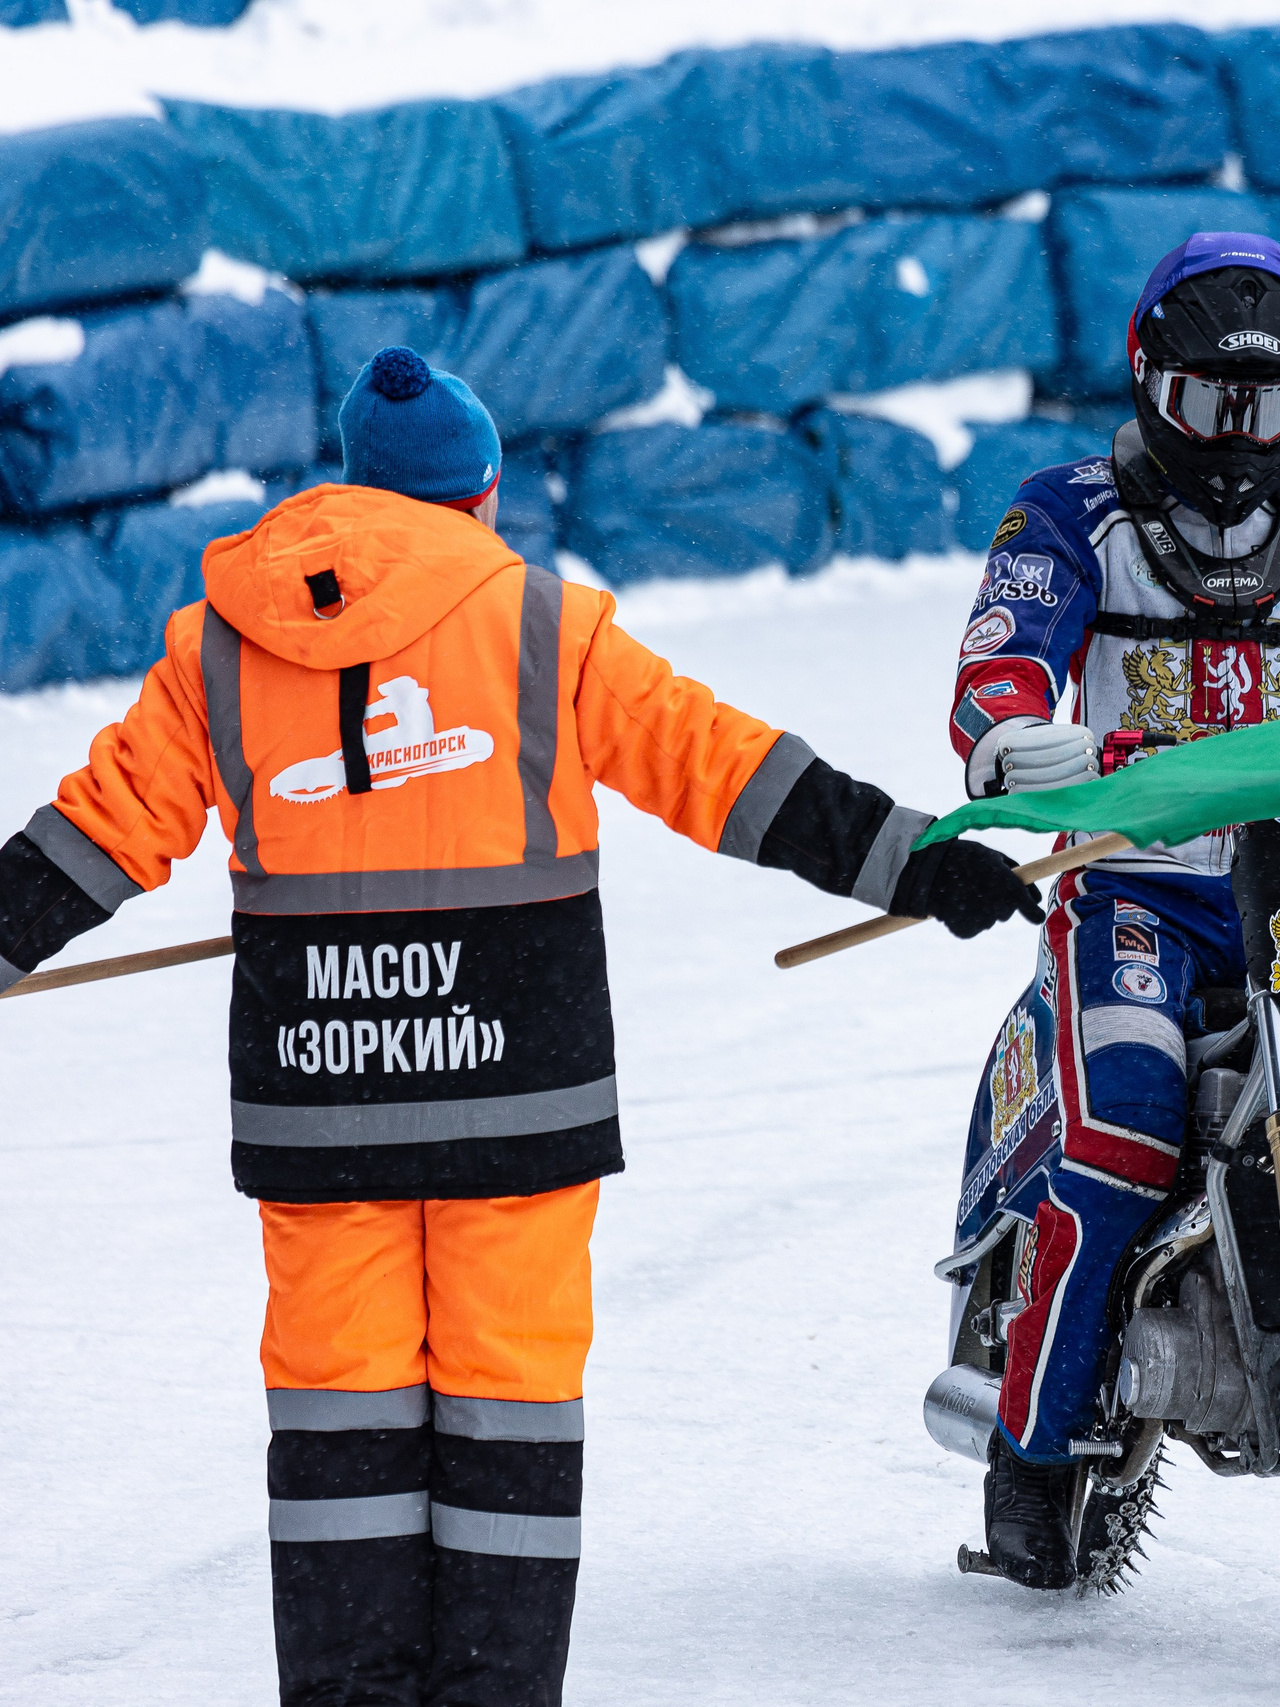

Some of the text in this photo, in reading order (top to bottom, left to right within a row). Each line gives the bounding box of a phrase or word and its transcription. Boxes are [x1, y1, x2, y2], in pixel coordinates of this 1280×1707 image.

[1228, 333, 1278, 352] SHOEI
[1206, 576, 1259, 589] ORTEMA
[367, 734, 466, 770] КРАСНОГОРСК
[306, 941, 462, 1000] МАСОУ
[277, 1003, 506, 1075] «ЗОРКИЙ»
[958, 1079, 1059, 1226] СВЕРДЛОВСКАЯ ОБЛА
